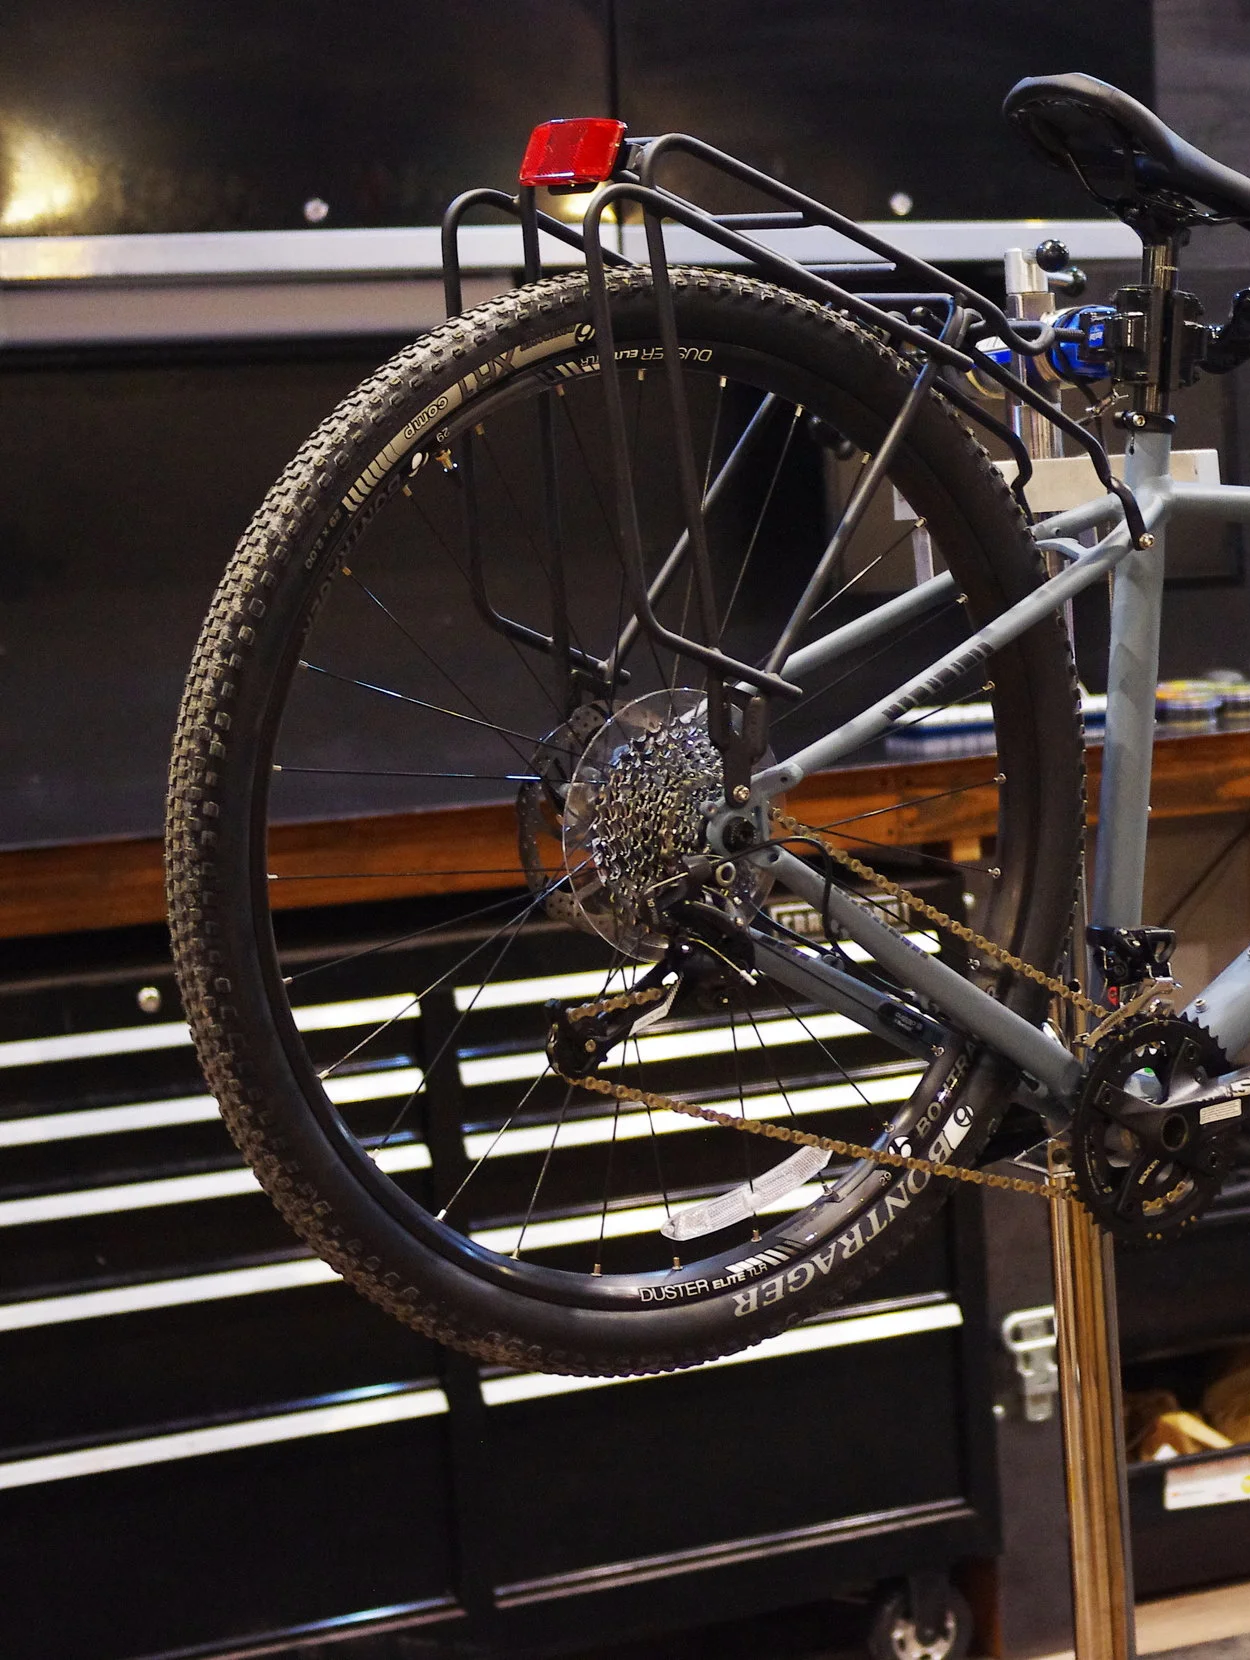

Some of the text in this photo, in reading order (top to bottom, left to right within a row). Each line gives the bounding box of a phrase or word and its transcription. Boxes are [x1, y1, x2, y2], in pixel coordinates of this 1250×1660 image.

[613, 349, 638, 361] ELIT
[639, 346, 713, 362] DUSER
[403, 396, 449, 439] comp
[436, 427, 450, 443] 29
[879, 1170, 893, 1186] 29
[733, 1129, 954, 1318] BONTRAGER
[639, 1262, 769, 1303] DUSTER ELITE TLR
